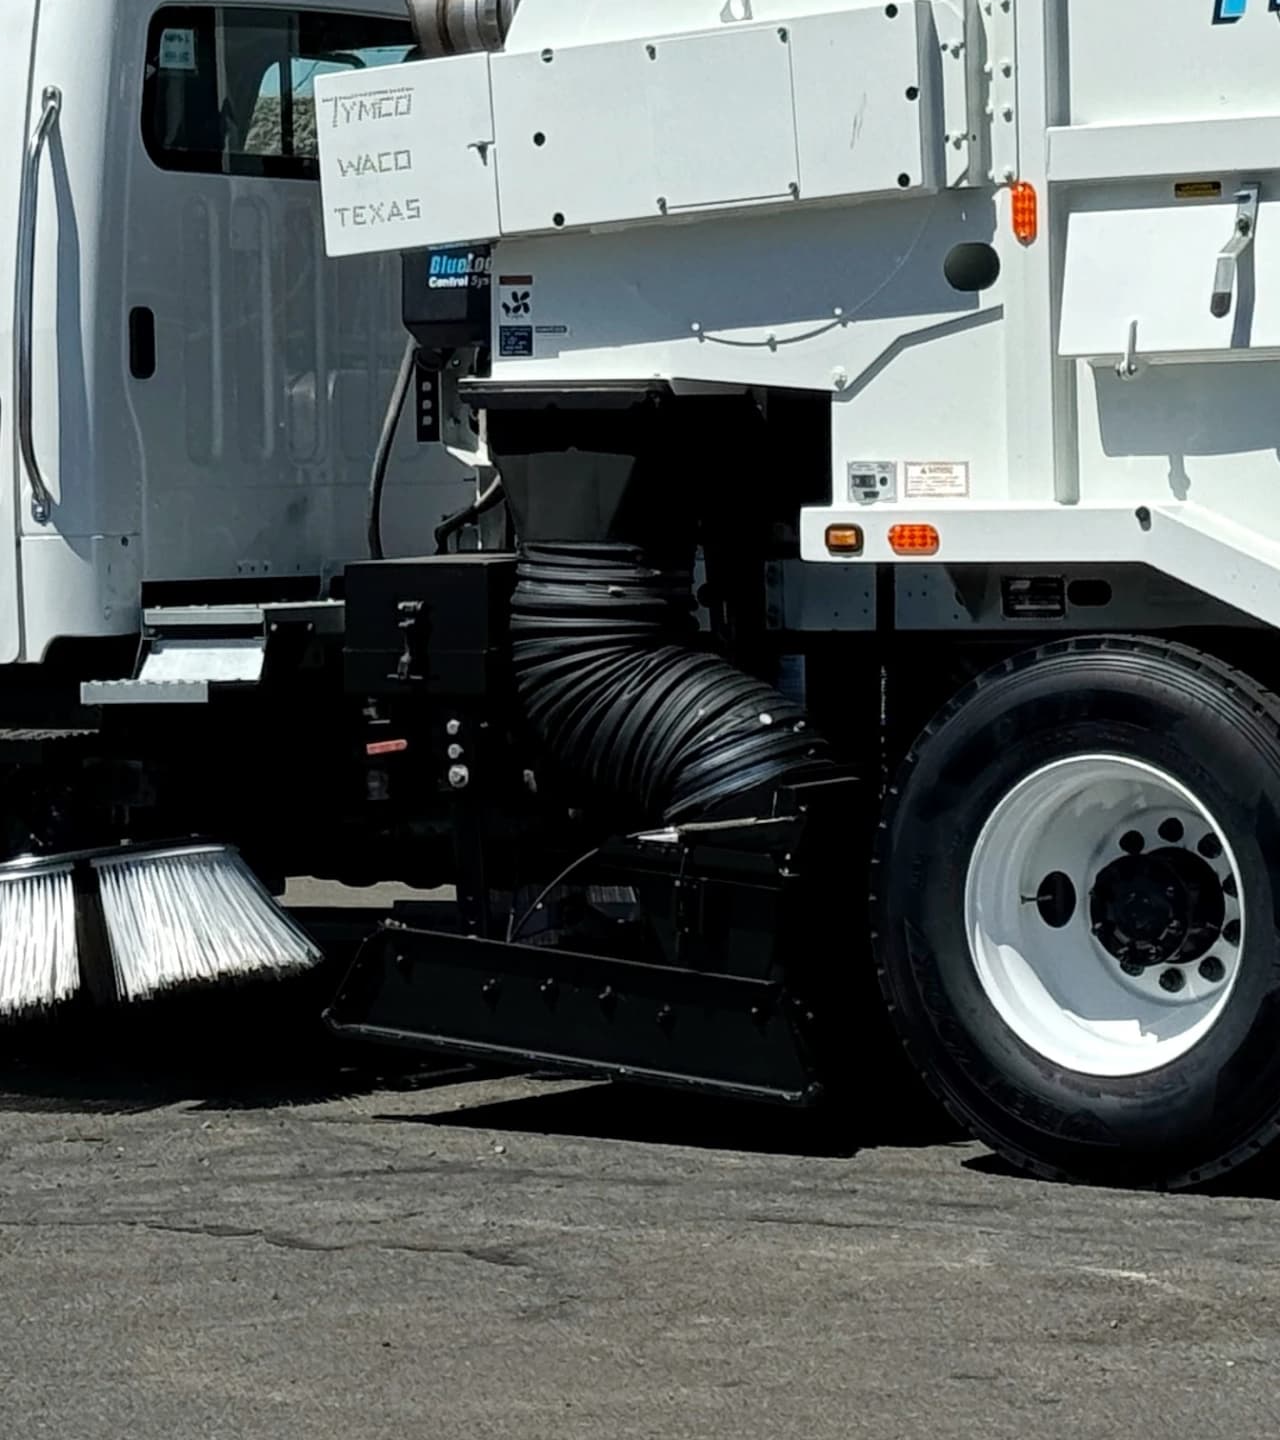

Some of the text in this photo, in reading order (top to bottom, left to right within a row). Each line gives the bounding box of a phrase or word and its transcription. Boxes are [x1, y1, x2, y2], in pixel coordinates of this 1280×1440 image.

[321, 87, 415, 128] TYMCO
[336, 149, 412, 177] WACO
[333, 198, 421, 228] TEXAS
[428, 274, 469, 289] Control
